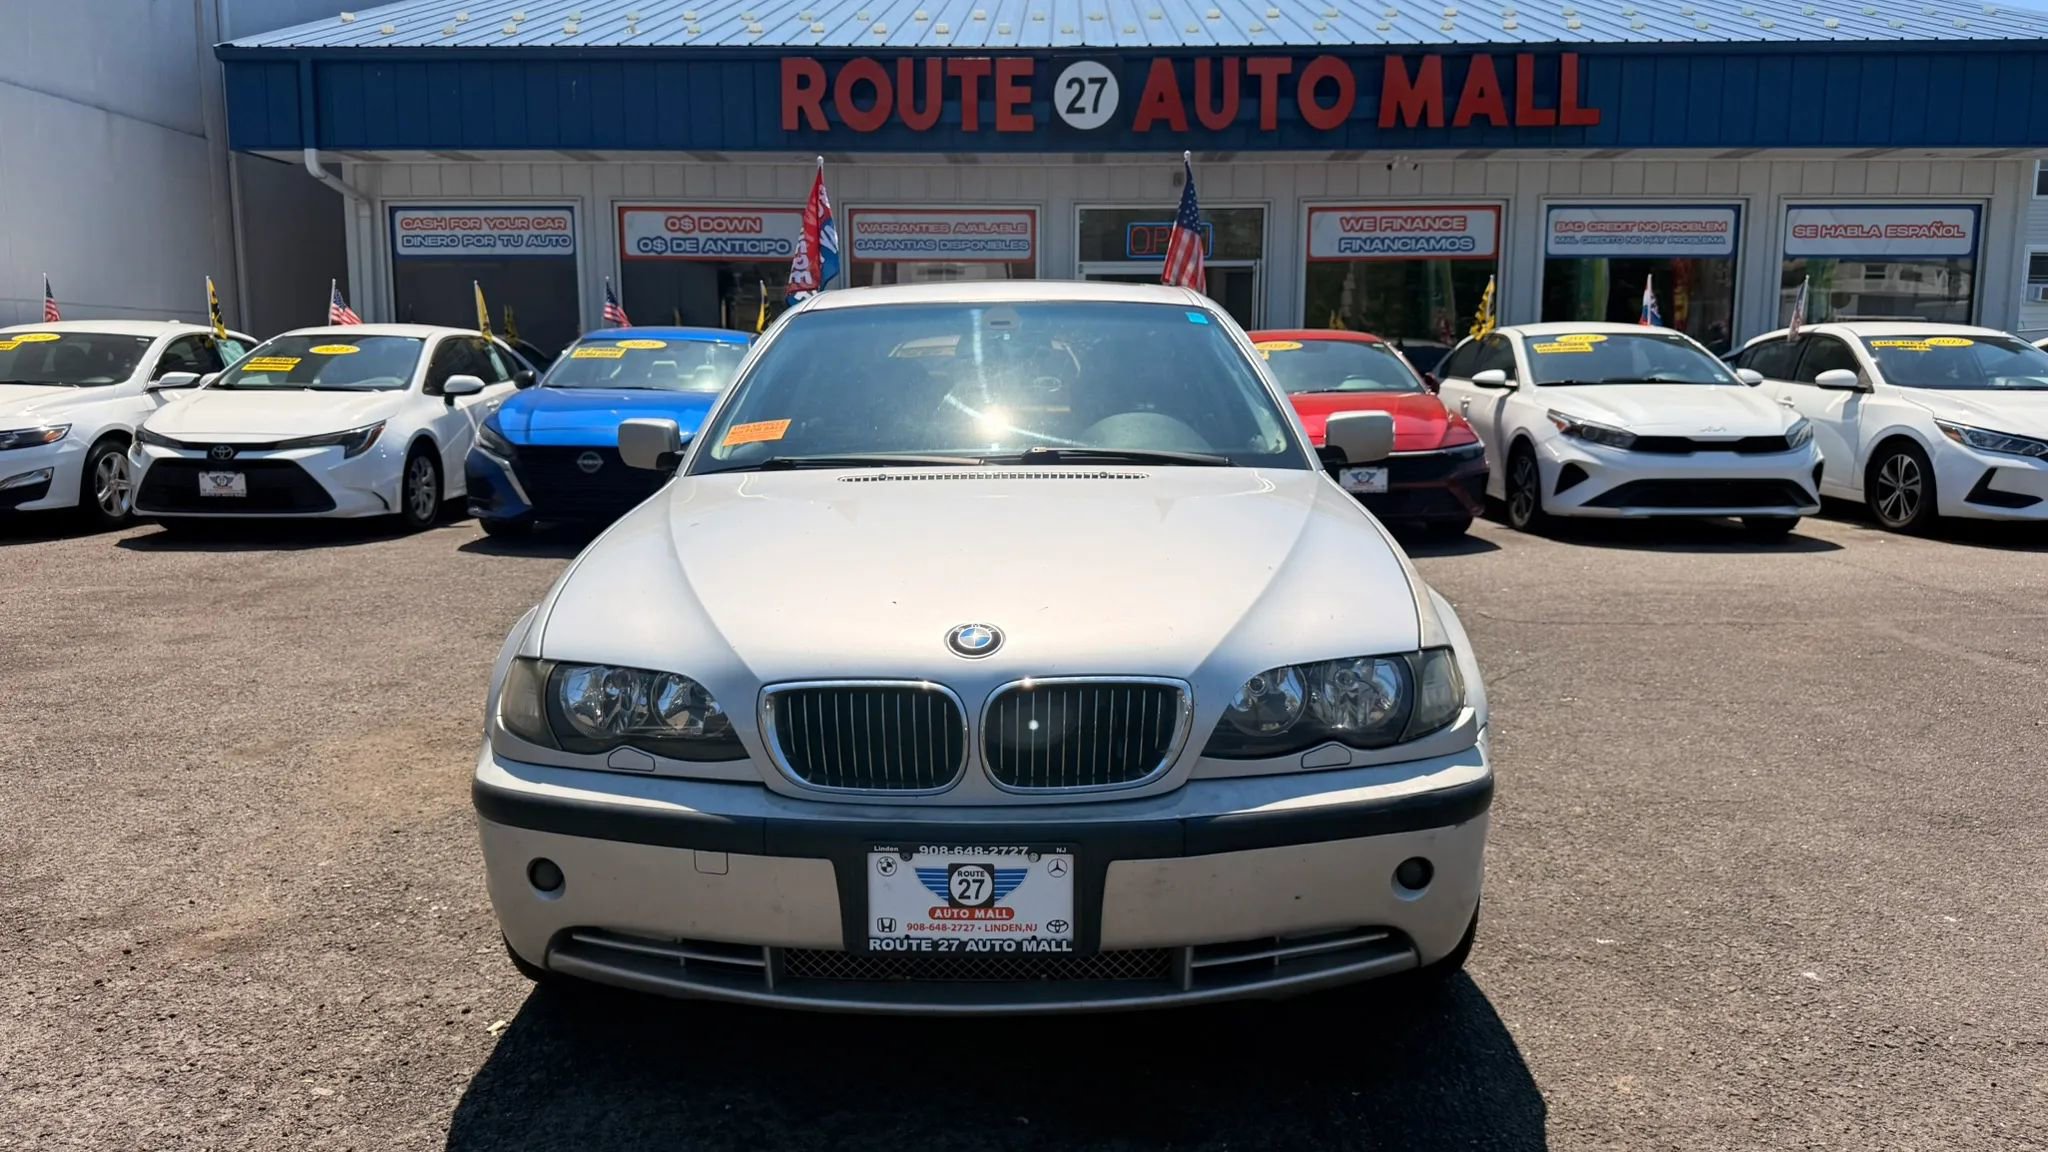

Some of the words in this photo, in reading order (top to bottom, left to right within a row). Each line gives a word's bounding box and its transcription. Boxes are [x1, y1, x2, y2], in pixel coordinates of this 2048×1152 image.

[780, 56, 1035, 133] ROUTE
[1065, 76, 1108, 115] 27
[1132, 55, 1357, 133] AUTO
[1377, 52, 1601, 129] MALL
[402, 218, 446, 230] CASH
[450, 218, 481, 230] FOR
[485, 218, 529, 230] YOUR
[532, 218, 566, 230] CAR
[700, 217, 761, 232] DOWN
[857, 222, 950, 233] WARRANTIES
[953, 222, 1027, 234] AVAILABLE
[1341, 217, 1376, 231] WE
[1381, 216, 1466, 231] FINANCE
[1556, 222, 1585, 232] BAD
[1588, 222, 1636, 232] CREDIT
[1639, 222, 1659, 232] NO
[1662, 222, 1727, 232] PROBLEM
[1793, 225, 1818, 238] SE
[1821, 225, 1881, 238] HABLA
[1886, 221, 1965, 238] ESPAÑOL
[403, 235, 458, 247] DINERO
[462, 235, 494, 247] POR
[500, 235, 521, 247] TU
[527, 235, 571, 247] AUTO
[671, 239, 697, 252] DE
[703, 240, 790, 253] ANTICIPO
[855, 239, 937, 250] GARANTIAS
[939, 239, 1030, 250] DISPONIBLES
[1340, 237, 1474, 252] FINANCIAMOS
[919, 845, 1028, 856] 908-648-2727
[957, 870, 985, 878] ROUTE
[957, 879, 985, 900] 27
[935, 909, 969, 919] AUTO
[975, 909, 1009, 919] MALL
[907, 923, 975, 932] 908-648-2727
[985, 924, 1038, 932] LINDEN,NJ
[869, 939, 932, 951] ROUTE
[938, 939, 960, 951] 27
[965, 940, 1016, 952] AUTO
[1022, 940, 1073, 952] MALL
